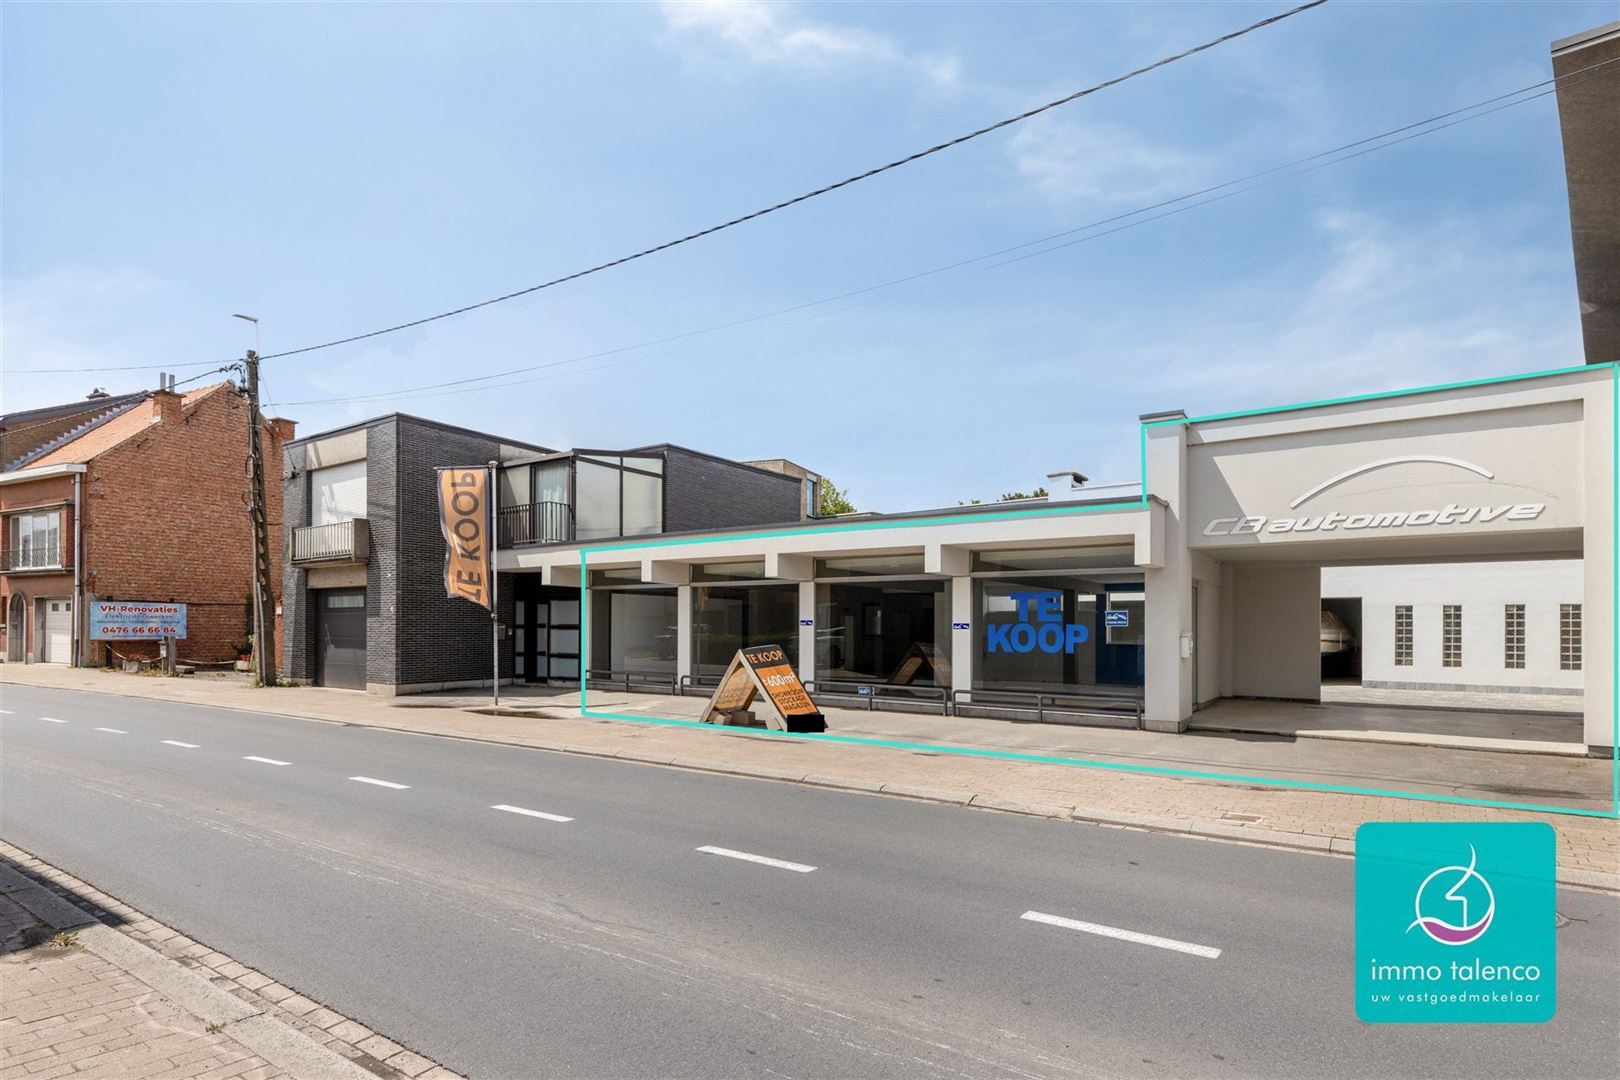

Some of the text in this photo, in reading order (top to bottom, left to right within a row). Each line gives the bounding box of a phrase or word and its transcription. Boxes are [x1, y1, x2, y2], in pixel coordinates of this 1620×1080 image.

[100, 605, 178, 613] VH-Renovaties
[1010, 591, 1064, 622] TE
[102, 626, 177, 634] 0476 66 66 84
[987, 623, 1089, 654] KOOP
[746, 650, 783, 664] TE KOOP
[771, 688, 804, 700] SHOWROOM
